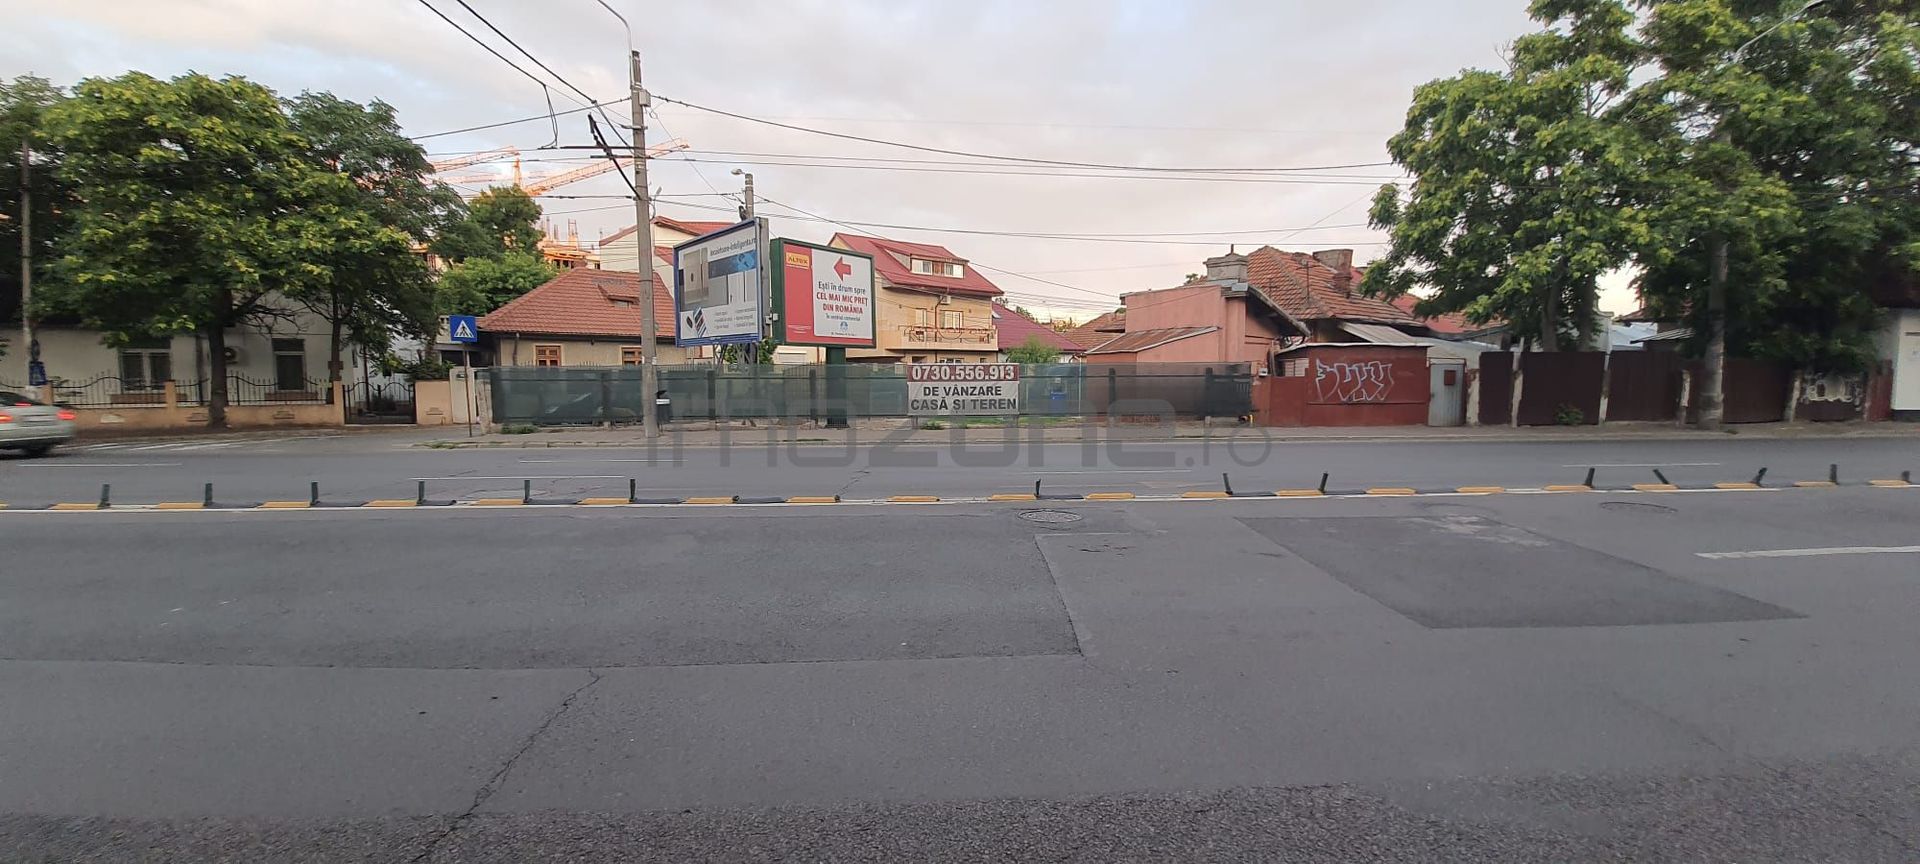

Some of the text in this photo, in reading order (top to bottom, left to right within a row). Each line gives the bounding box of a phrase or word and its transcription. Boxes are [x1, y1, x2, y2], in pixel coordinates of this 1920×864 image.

[838, 284, 853, 292] drum
[854, 287, 866, 295] spre
[816, 292, 827, 301] CEL
[829, 294, 841, 302] MAI
[842, 295, 853, 303] MIC
[822, 303, 863, 314] DIN ROMÂNIA
[912, 365, 1015, 380] 0730.556.913
[923, 384, 1002, 396] DE VÂNZARE
[910, 397, 948, 410] CASĂ
[970, 398, 1017, 410] TEREN
